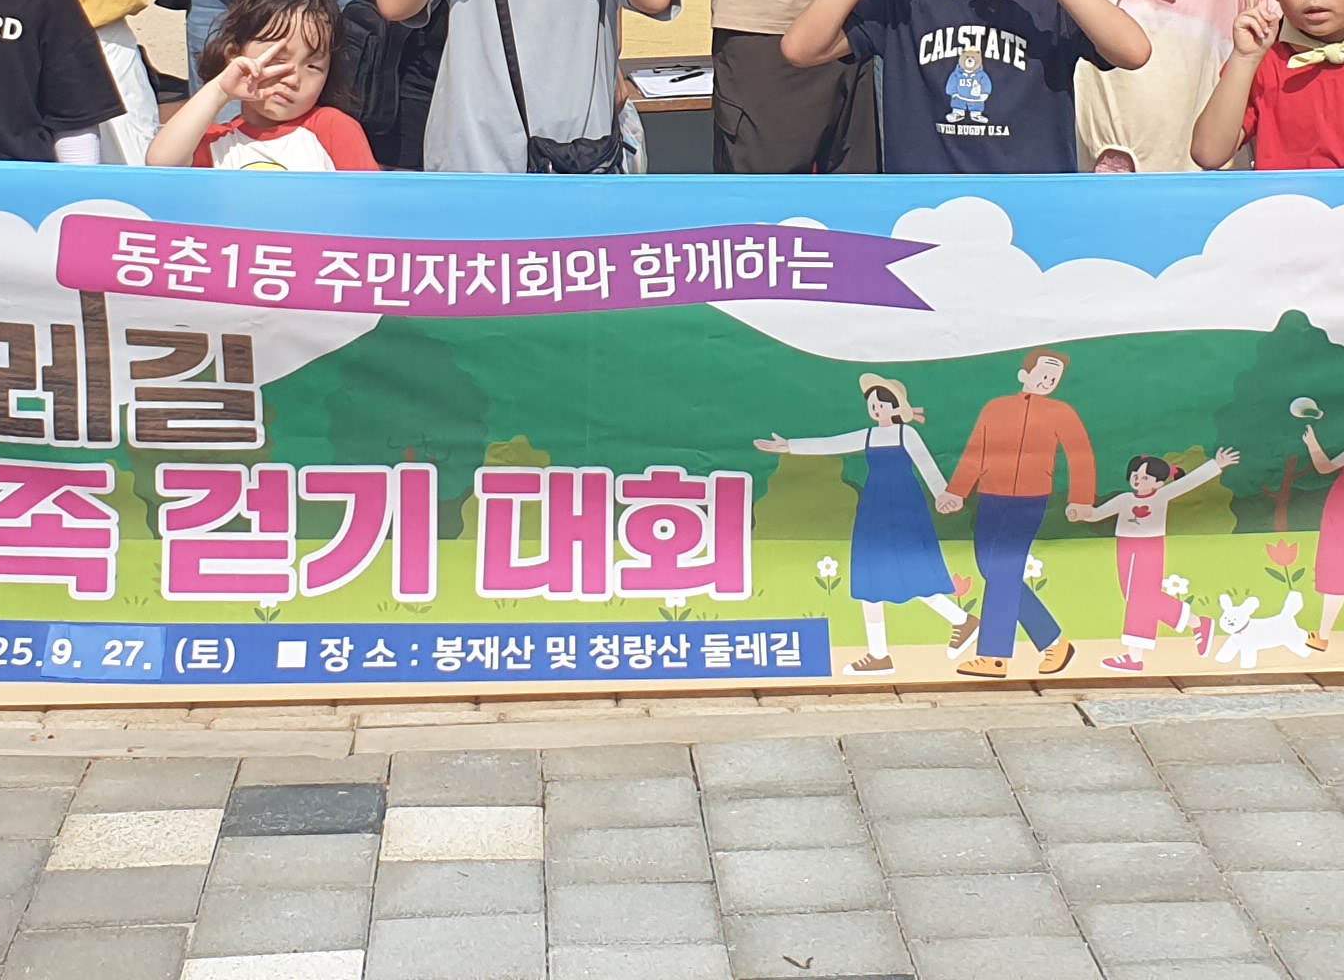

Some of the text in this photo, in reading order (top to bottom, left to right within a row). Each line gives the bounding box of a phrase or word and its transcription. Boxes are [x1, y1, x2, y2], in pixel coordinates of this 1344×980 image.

[919, 25, 1027, 71] CALSTATE
[957, 125, 986, 136] RUGBY
[111, 230, 835, 307] 동춘1동 주민자치회와 함께하는
[162, 468, 432, 598] 걷기
[480, 469, 748, 597] 대회
[101, 639, 153, 670] 27.
[174, 637, 237, 673] (토)
[432, 635, 535, 671] 봉재산
[546, 634, 577, 671] 및
[588, 633, 688, 671] 청량산
[700, 631, 802, 668] 둘레길
